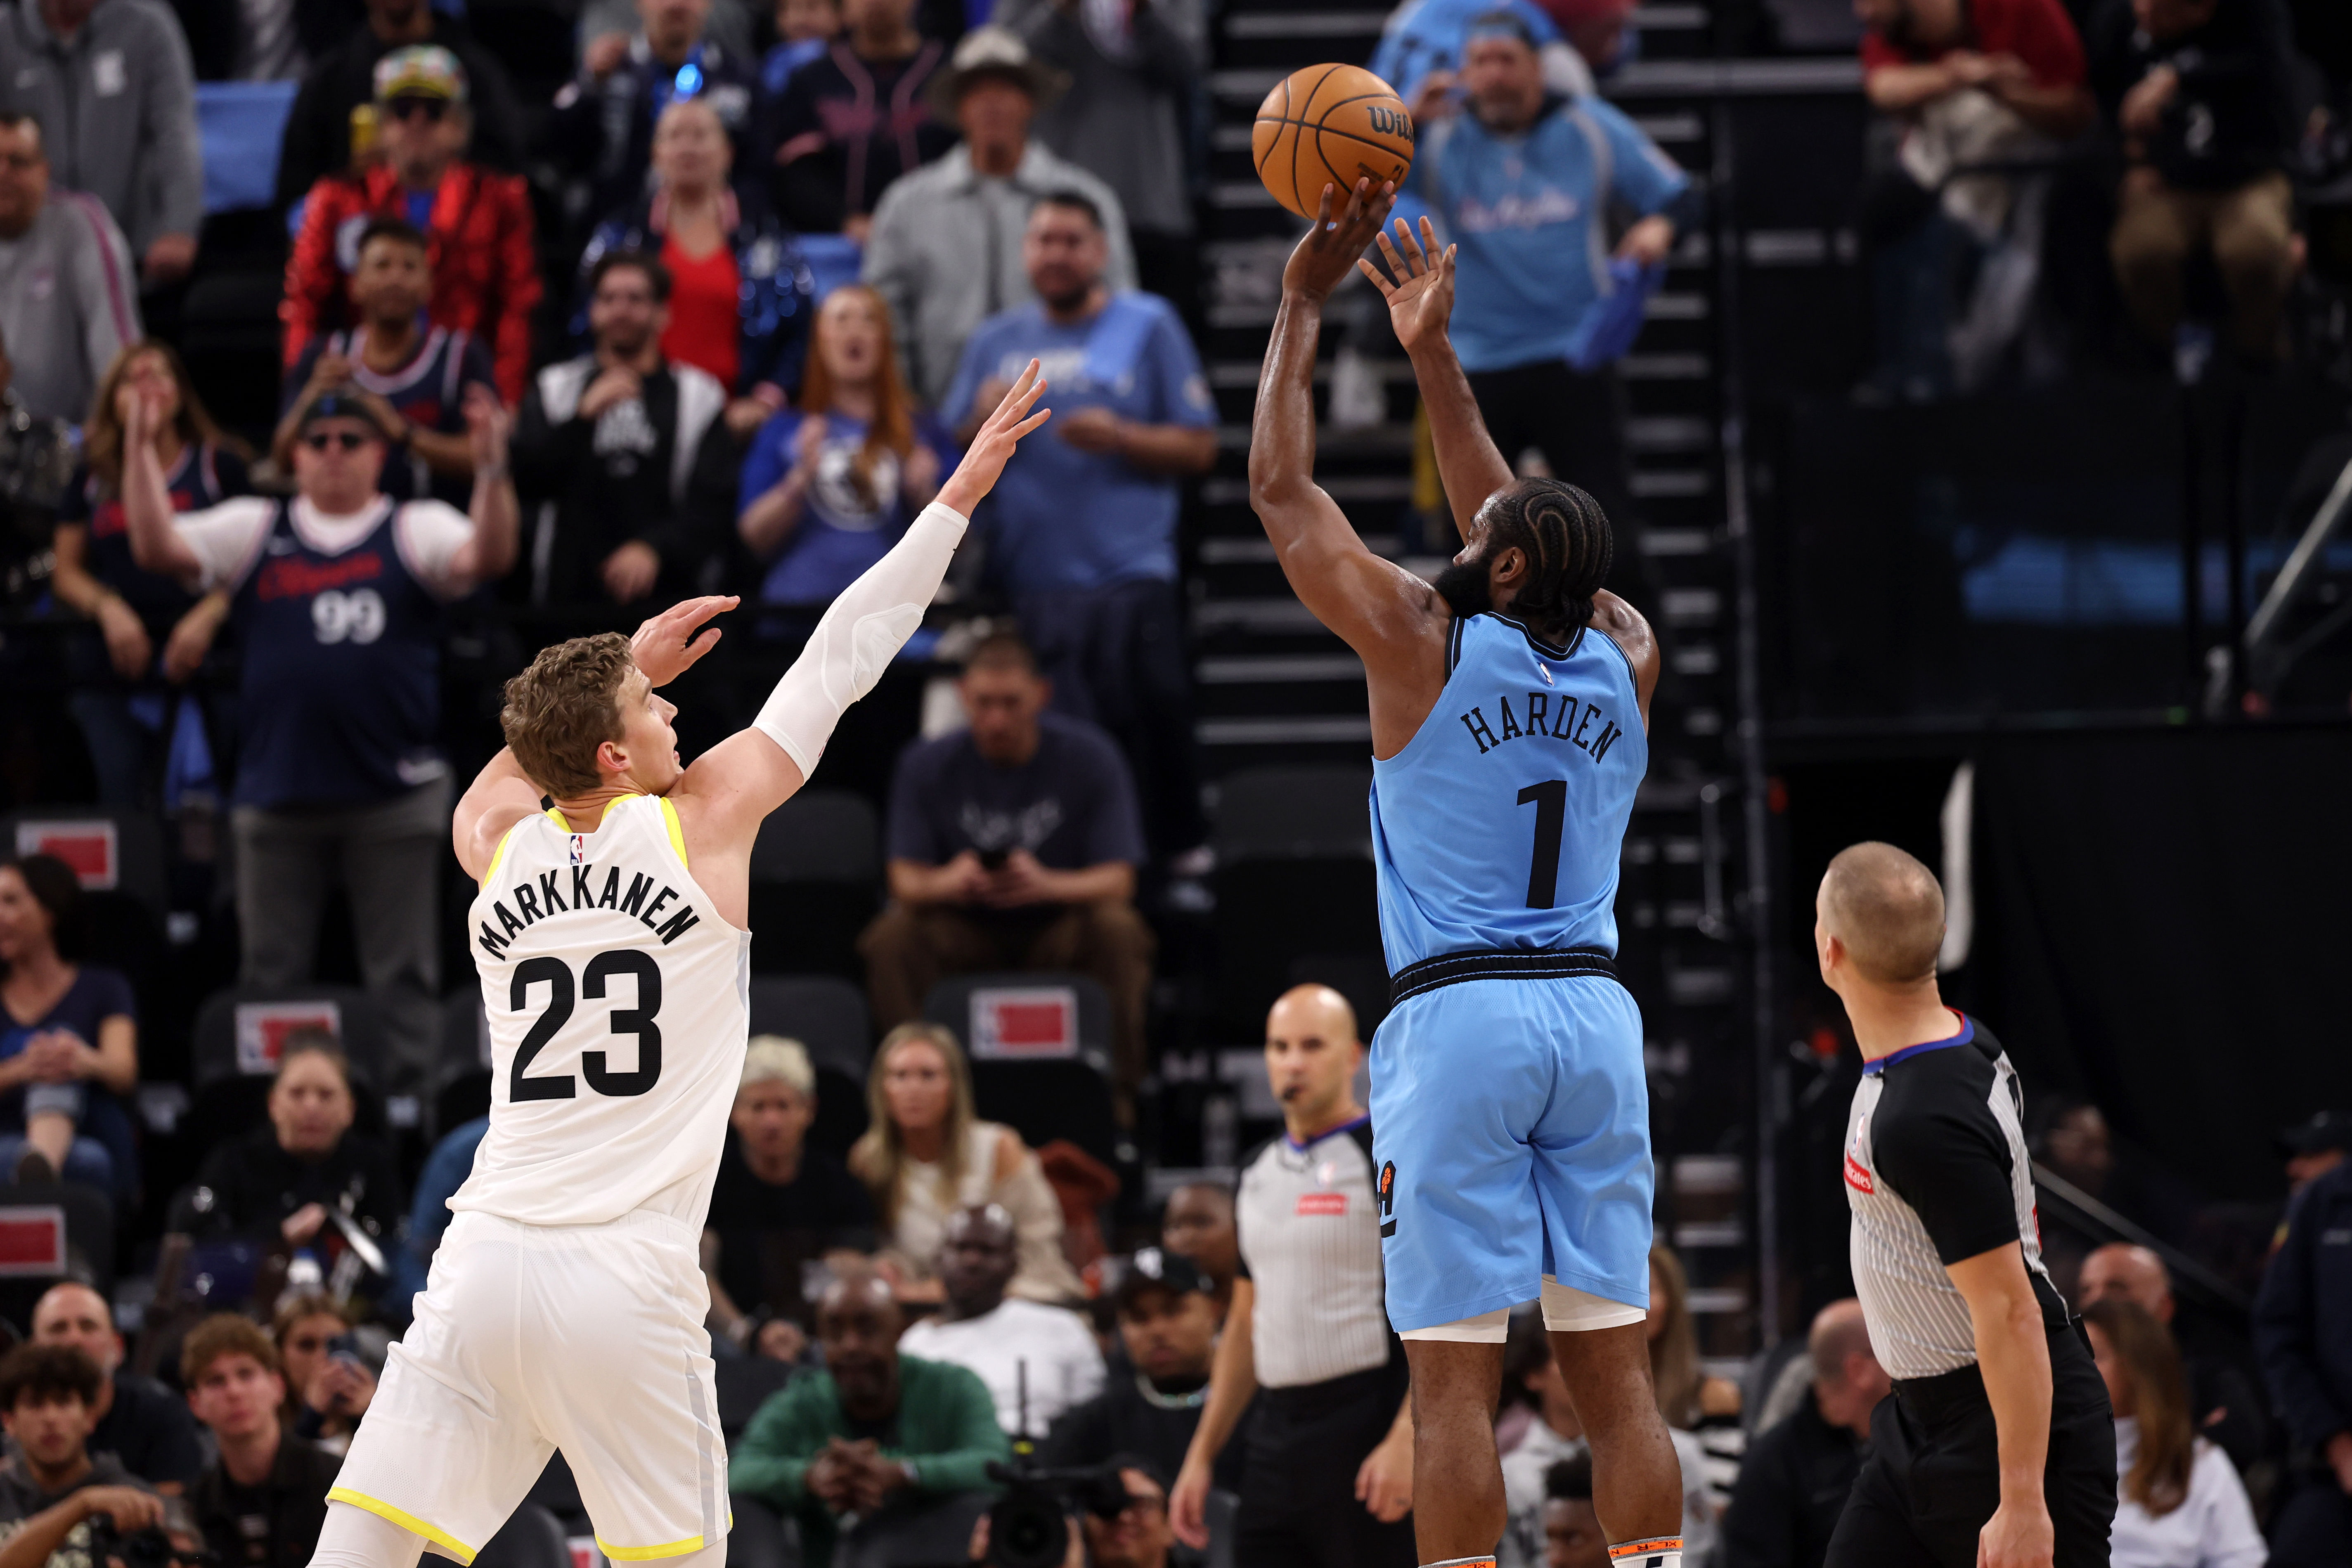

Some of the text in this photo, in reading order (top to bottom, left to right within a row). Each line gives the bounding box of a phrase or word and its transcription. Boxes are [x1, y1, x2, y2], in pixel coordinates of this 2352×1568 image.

[311, 587, 387, 645] 99
[1460, 692, 1622, 764] HARDEN
[1517, 780, 1567, 910] 1
[479, 864, 700, 961] MARKKANEN
[510, 949, 662, 1103] 23
